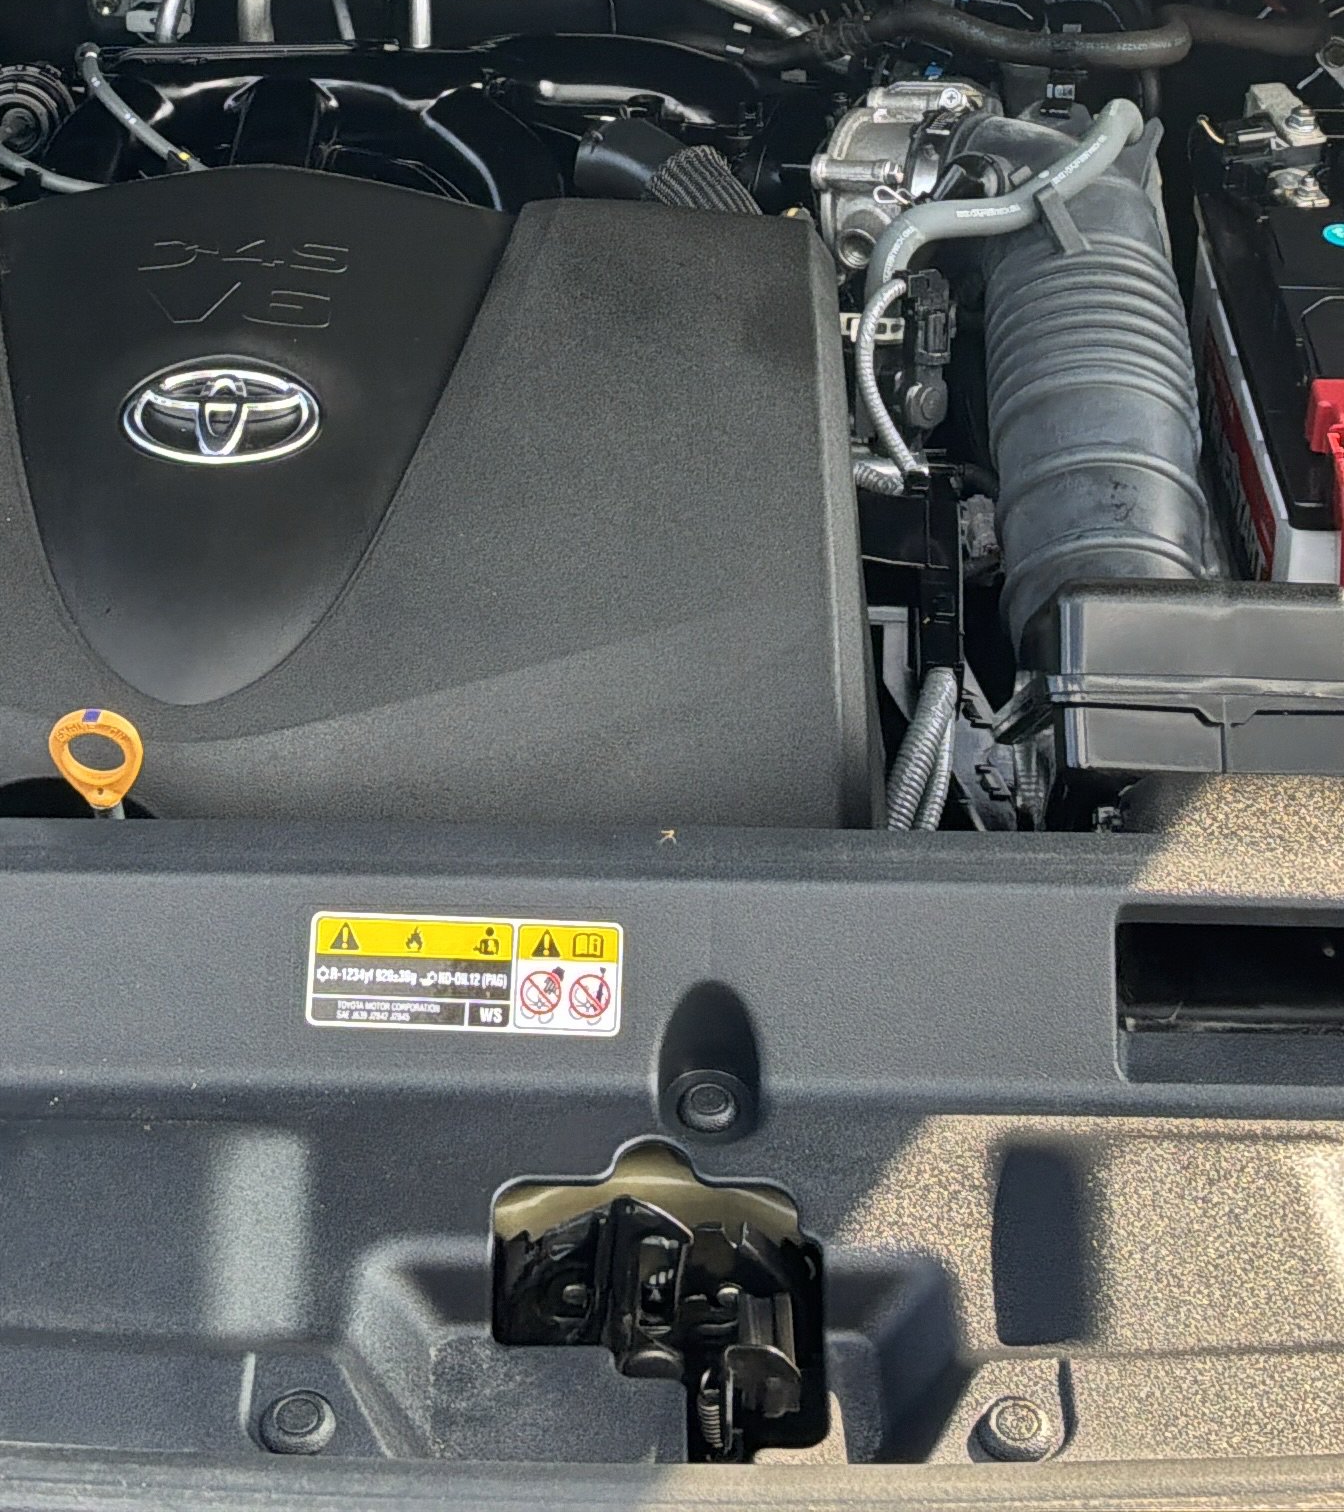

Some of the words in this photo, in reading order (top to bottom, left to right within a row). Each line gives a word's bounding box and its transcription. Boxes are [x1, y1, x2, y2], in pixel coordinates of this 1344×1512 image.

[146, 280, 332, 329] V6
[481, 972, 508, 990] (PAG)
[336, 1010, 351, 1020] SAE
[337, 999, 365, 1011] TOYOTA
[365, 1000, 391, 1012] MOTOR
[391, 1001, 441, 1014] CORPORATION
[479, 1006, 504, 1025] WS
